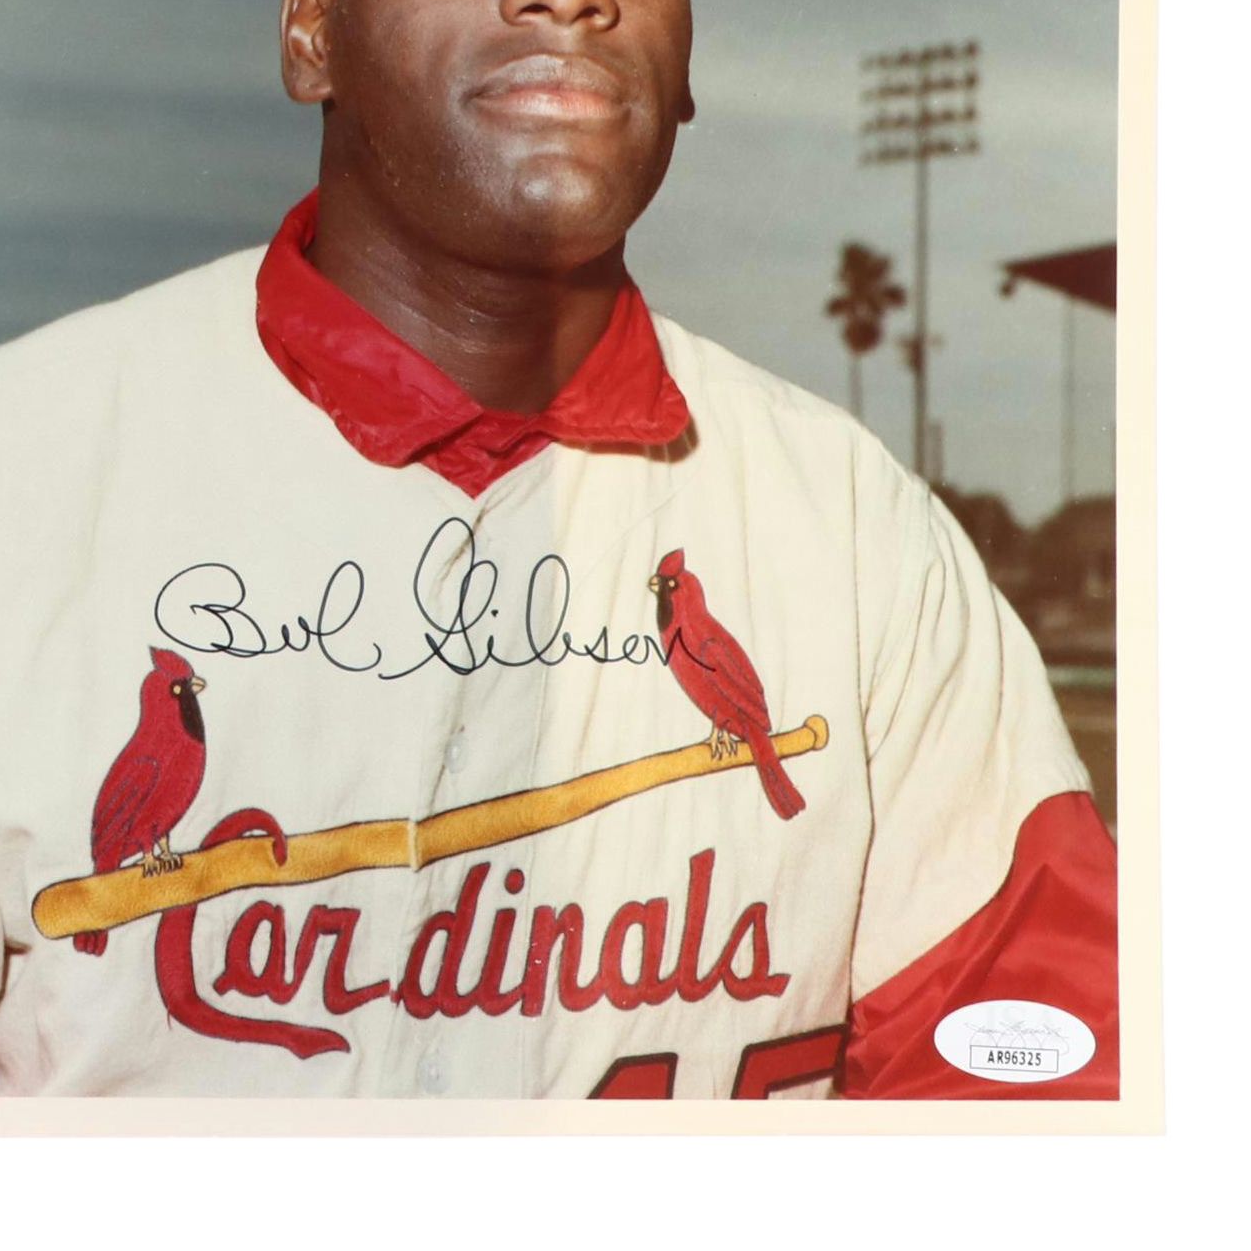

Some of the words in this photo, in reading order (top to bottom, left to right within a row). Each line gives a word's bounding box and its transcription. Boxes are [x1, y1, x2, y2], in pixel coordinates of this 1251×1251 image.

[378, 517, 717, 680] Gibson
[154, 807, 791, 1060] Cardinals
[987, 1050, 1042, 1067] AR96325
